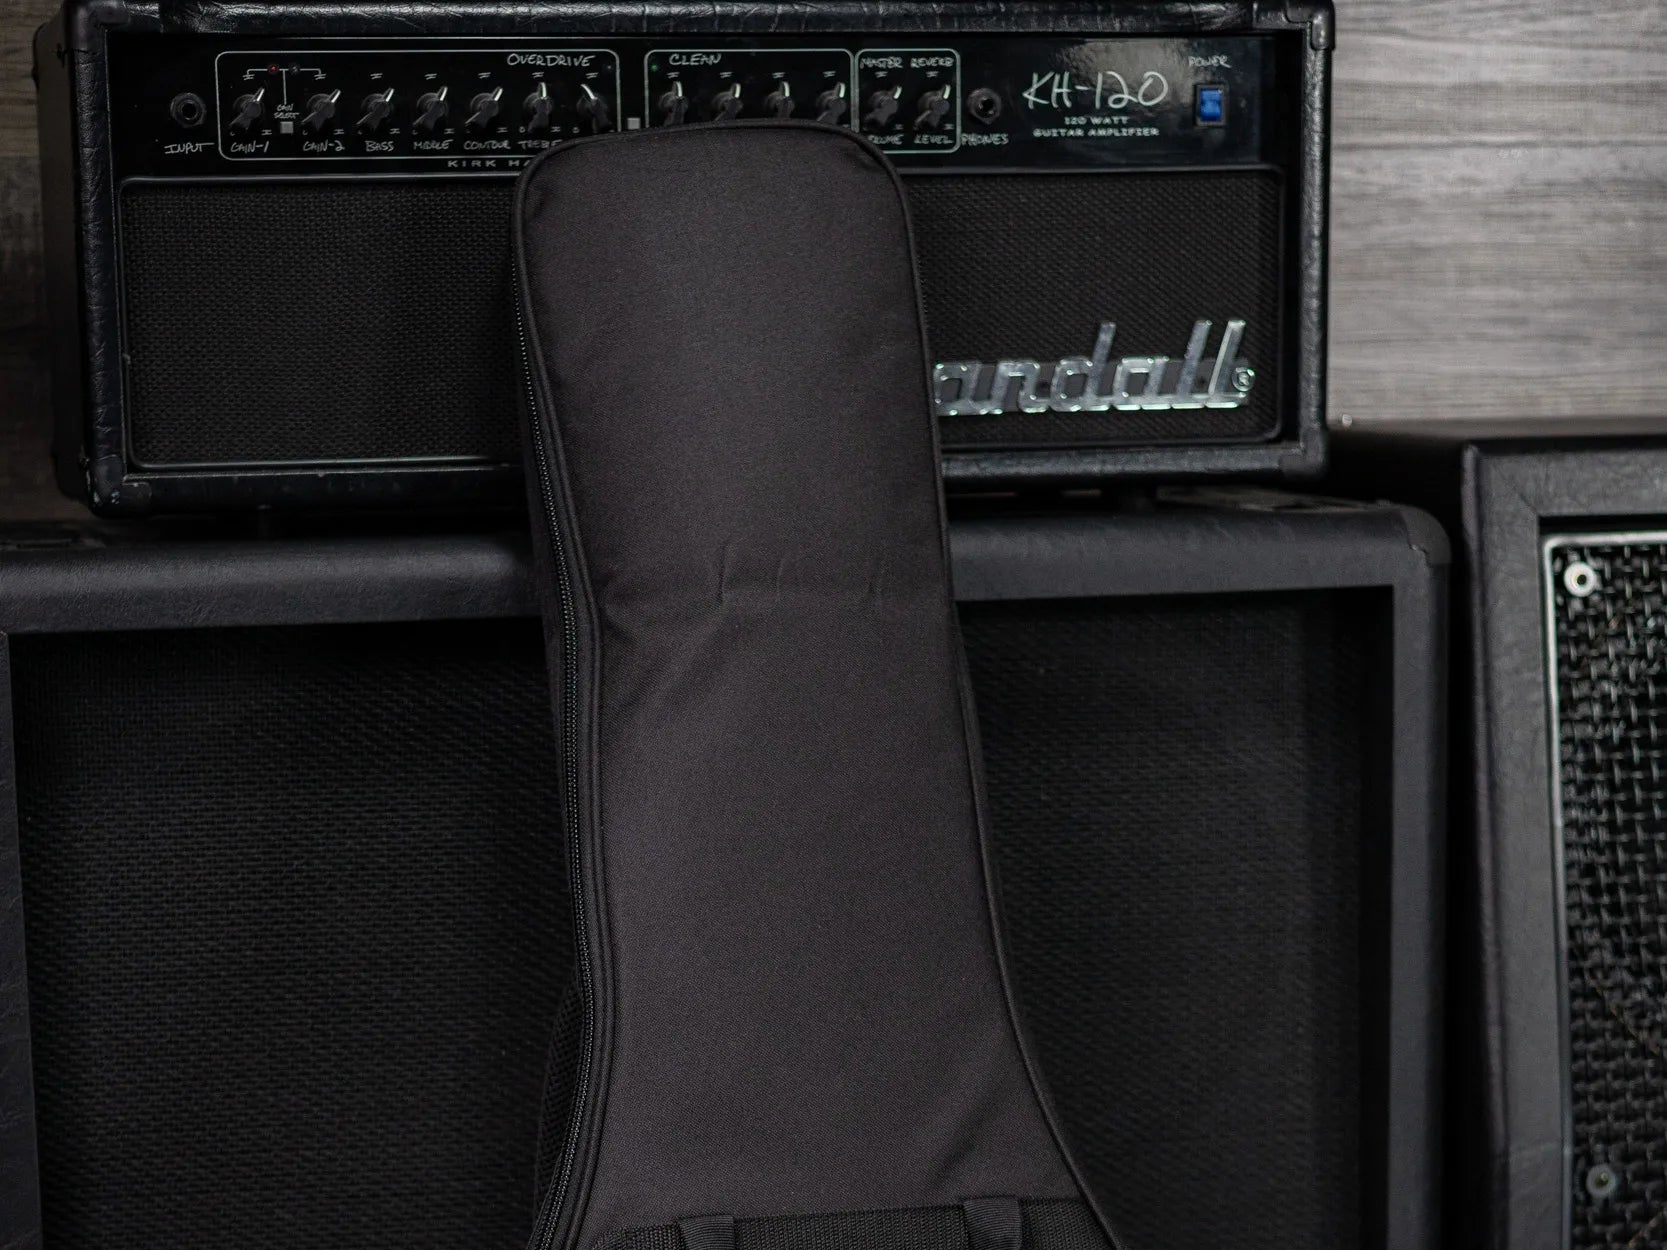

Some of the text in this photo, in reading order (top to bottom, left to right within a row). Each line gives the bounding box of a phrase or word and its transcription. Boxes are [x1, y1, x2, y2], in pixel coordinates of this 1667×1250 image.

[506, 54, 596, 67] OVERDRIVE
[668, 53, 722, 66] CLEAN
[1188, 55, 1231, 68] POWER
[1022, 71, 1168, 110] KH-120
[1064, 116, 1129, 125] 120 WATT
[1032, 127, 1160, 137] GUITAR AMPLIFIER
[913, 134, 954, 144] LEVEL
[961, 133, 1009, 147] PHONES
[164, 142, 215, 154] INPUT
[230, 140, 270, 153] GAIN-1
[302, 140, 346, 153] GAIN-2
[364, 140, 395, 152] BASS
[932, 320, 1248, 414] andall
